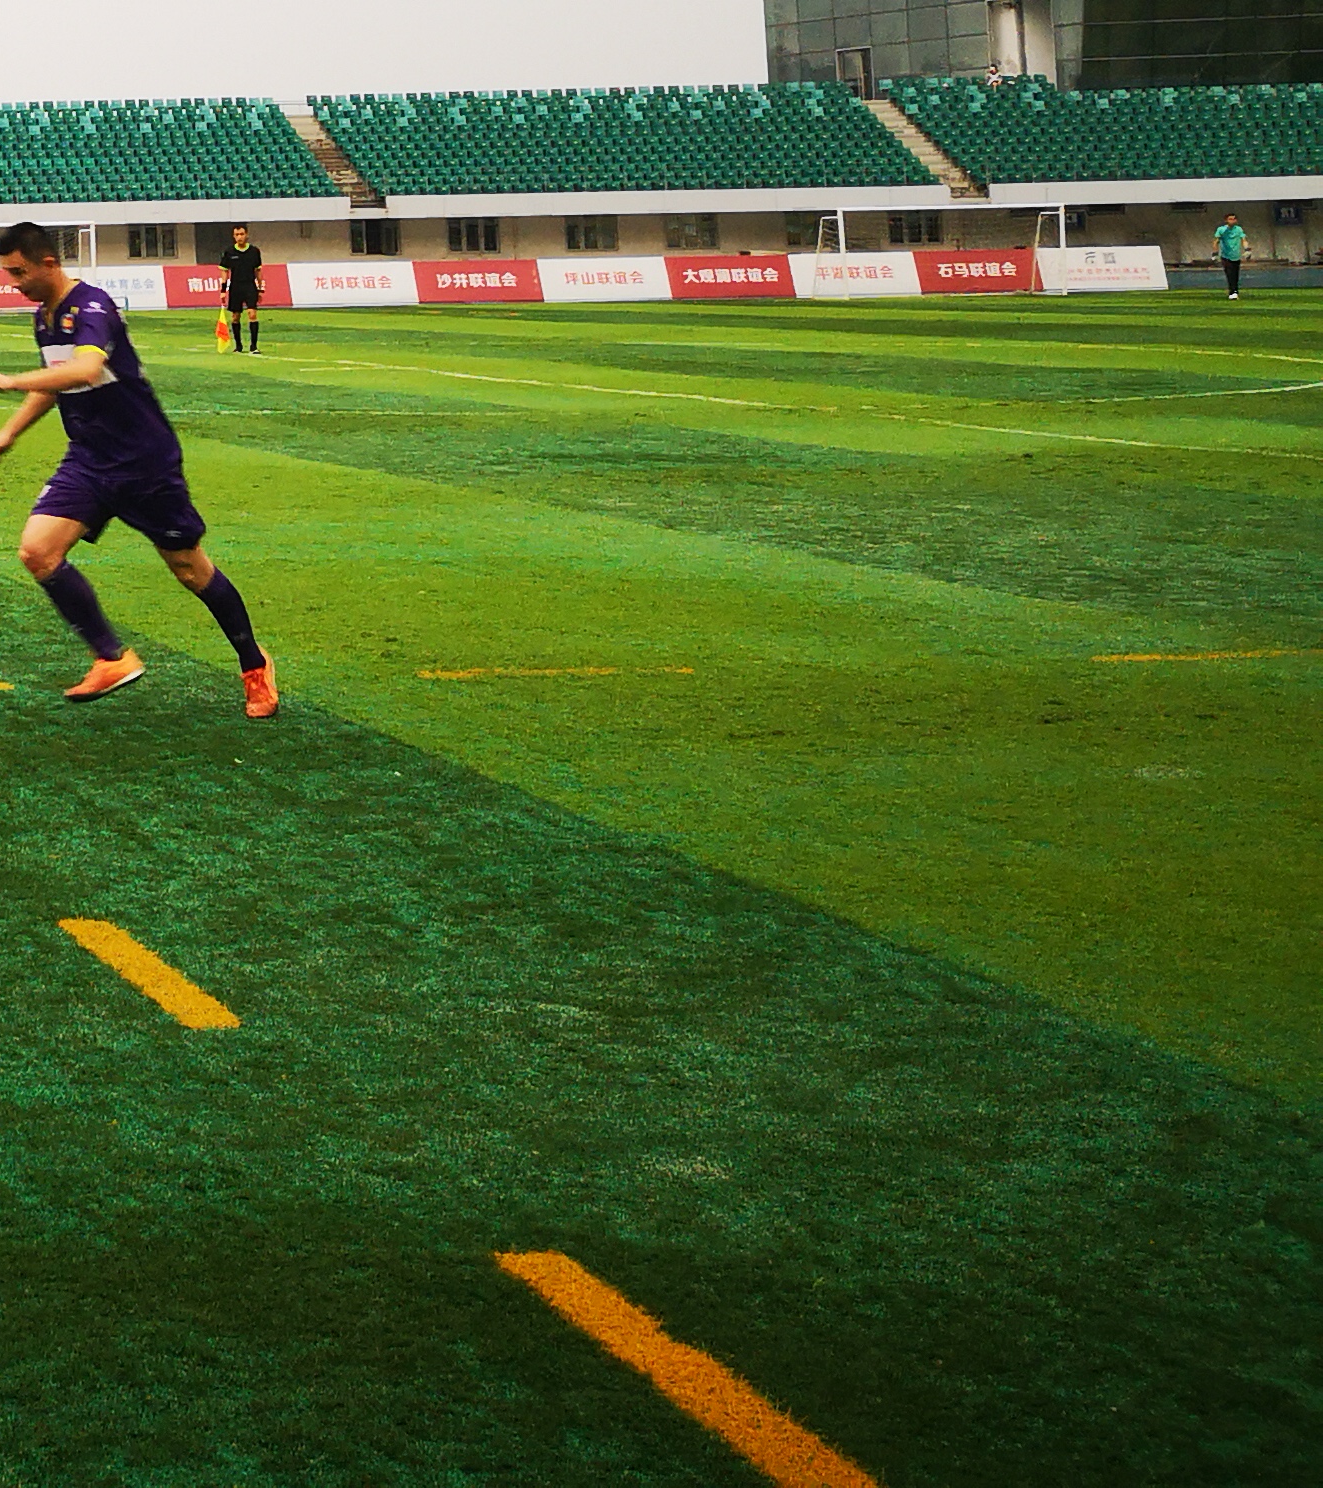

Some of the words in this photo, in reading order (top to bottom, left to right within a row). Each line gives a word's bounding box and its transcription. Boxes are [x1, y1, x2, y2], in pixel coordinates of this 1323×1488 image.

[682, 268, 779, 283] 大观澜联谊会
[937, 261, 1017, 278] 石马联谊会
[314, 275, 392, 290] 龙岗联谊会
[436, 272, 517, 289] 沙井联谊会
[565, 270, 644, 285] 坪山联谊会
